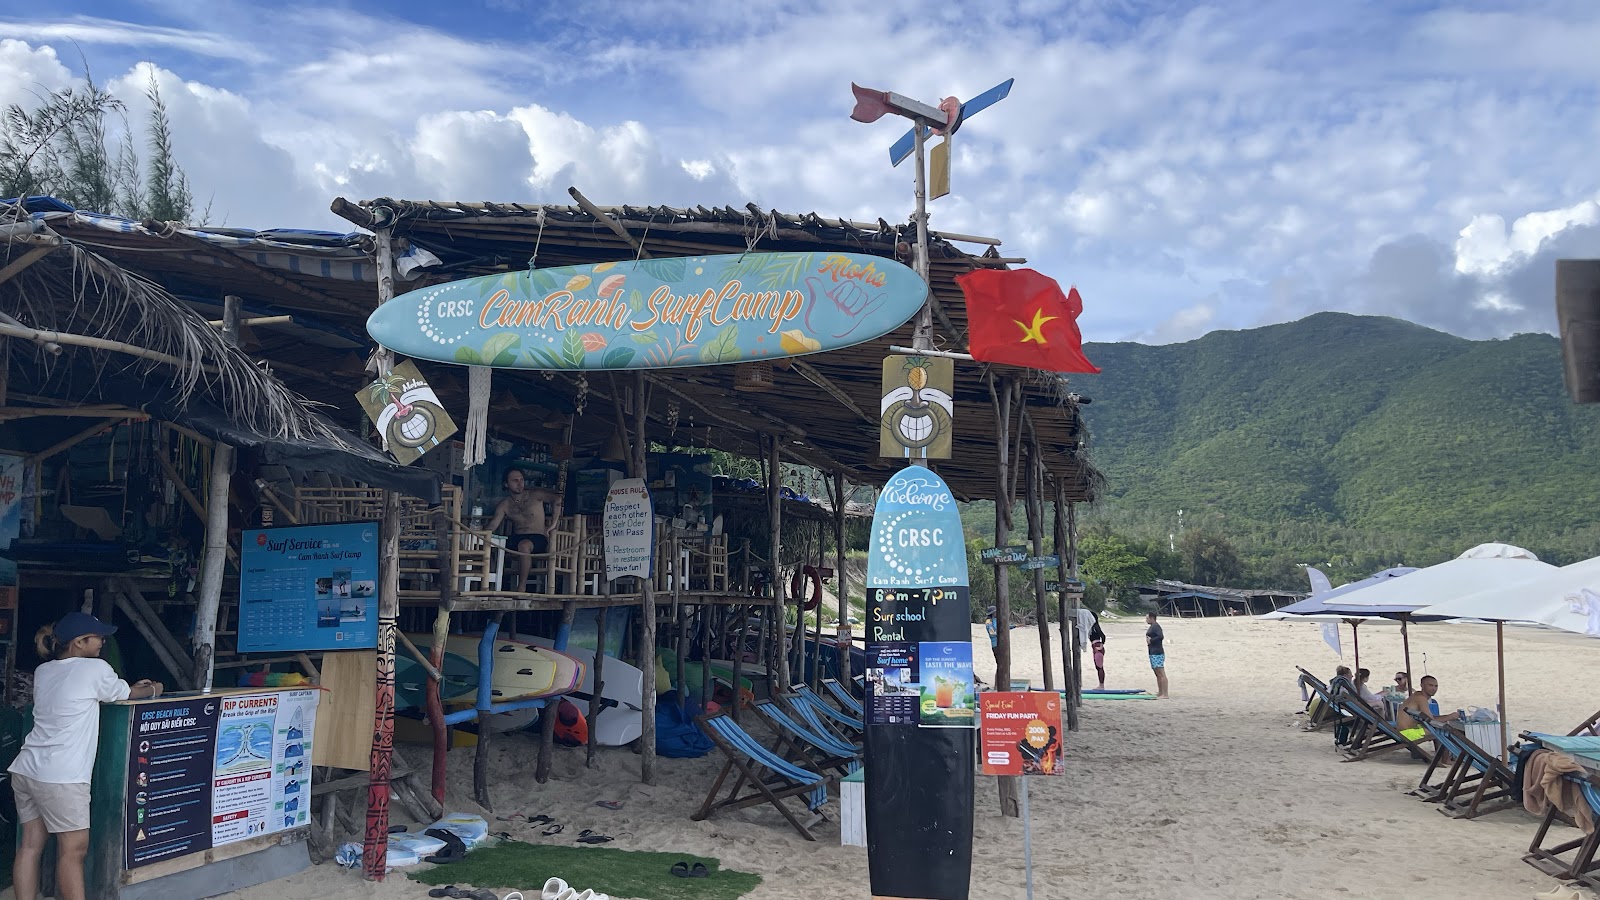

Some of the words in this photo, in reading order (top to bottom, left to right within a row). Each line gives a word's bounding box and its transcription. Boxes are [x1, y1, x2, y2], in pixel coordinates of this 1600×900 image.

[818, 254, 888, 288] Aloha
[437, 299, 474, 318] CRSC
[884, 478, 951, 511] Welcome
[610, 503, 640, 513] Respect
[608, 511, 626, 520] each
[629, 510, 647, 518] other
[898, 528, 943, 547] CRSC
[267, 539, 288, 554] Surf
[289, 537, 323, 551] Service
[613, 545, 645, 554] Restroom
[331, 551, 343, 560] Surf
[344, 550, 362, 560] Camp
[620, 554, 650, 563] restaurant
[1012, 552, 1027, 561] DAY
[873, 576, 888, 585] Cam
[890, 576, 910, 585] Ranh
[915, 575, 934, 585] Surf
[938, 575, 958, 585] Camp
[1045, 582, 1056, 592] Life
[873, 607, 894, 625] Surf
[896, 606, 926, 621] school
[873, 626, 905, 642] Rental
[877, 657, 891, 666] Surf
[224, 700, 236, 710] RIP
[238, 698, 277, 709] CURRENTS
[141, 711, 155, 720] CRSC
[156, 709, 173, 719] BEACH
[173, 708, 190, 717] RULES
[150, 721, 161, 730] QUY
[183, 718, 196, 726] CRSC
[1028, 726, 1045, 734] 200k
